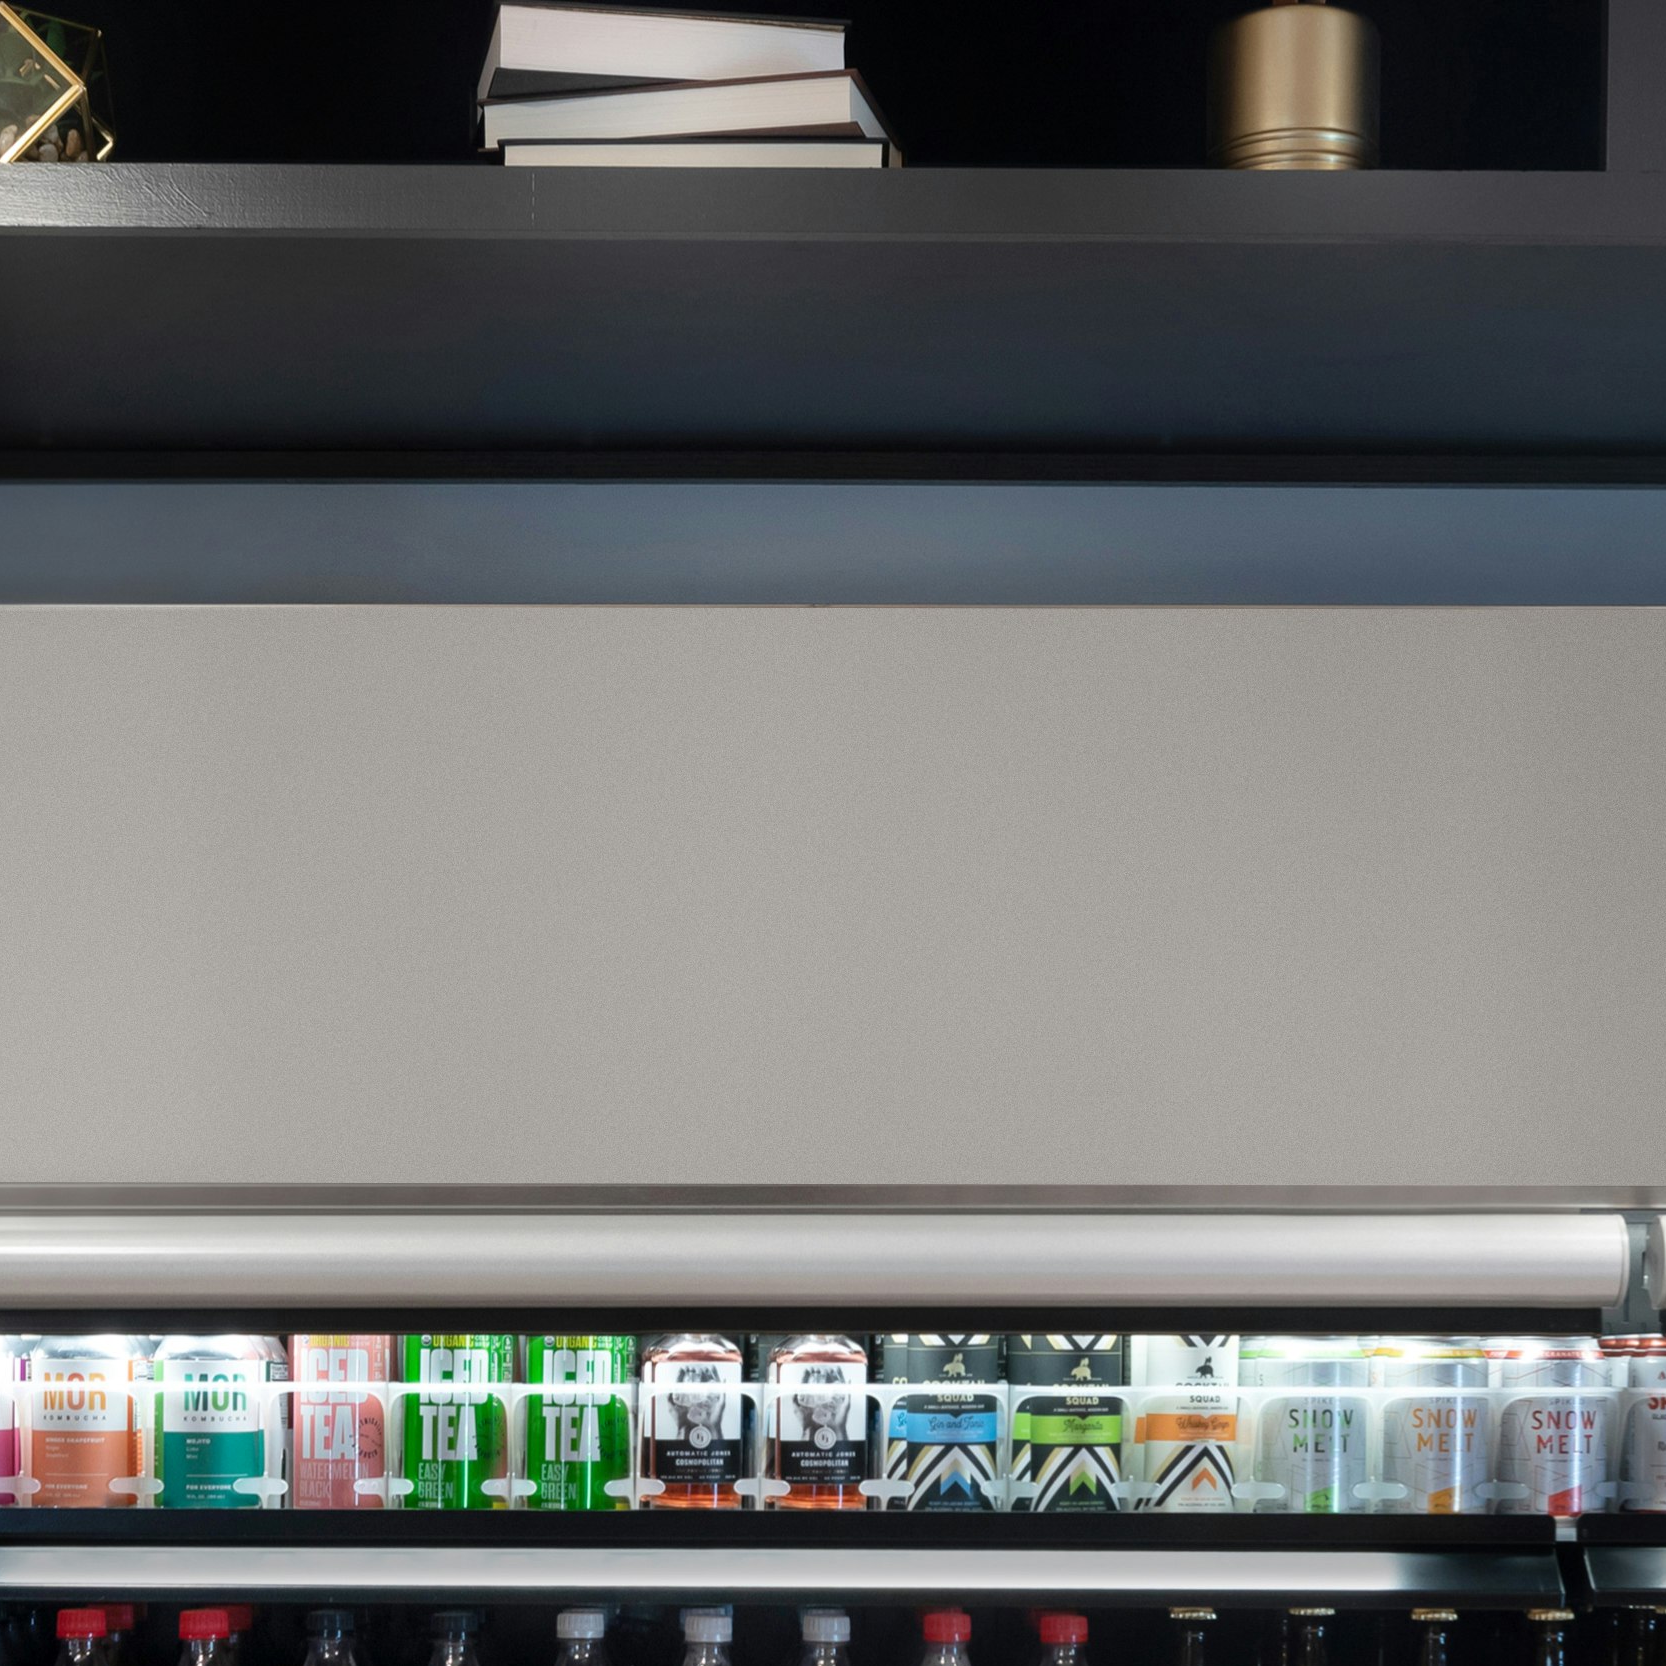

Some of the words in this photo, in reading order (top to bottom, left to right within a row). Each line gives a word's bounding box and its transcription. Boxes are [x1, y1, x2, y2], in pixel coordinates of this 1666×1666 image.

[299, 1349, 369, 1405] ICED
[419, 1349, 490, 1405] ICED
[543, 1349, 613, 1406] ICED
[1066, 1396, 1100, 1406] SQUAD
[1190, 1395, 1221, 1404] SQUAD
[1289, 1410, 1354, 1430] SNOW
[1412, 1410, 1478, 1430] SNOW
[1531, 1411, 1598, 1430] SNOW
[301, 1406, 358, 1460] TEA
[420, 1405, 479, 1462] TEA
[543, 1405, 601, 1463] TEA
[1417, 1434, 1475, 1454] MELT
[1536, 1435, 1594, 1455] MELT
[418, 1463, 447, 1482] EASY
[540, 1463, 569, 1482] EASY
[675, 1459, 725, 1467] COSMOPOLITAN
[800, 1460, 850, 1468] COSMOPOLITAN
[299, 1481, 333, 1500] BLACK
[418, 1482, 454, 1501] GREEN
[540, 1482, 577, 1501] GREEN
